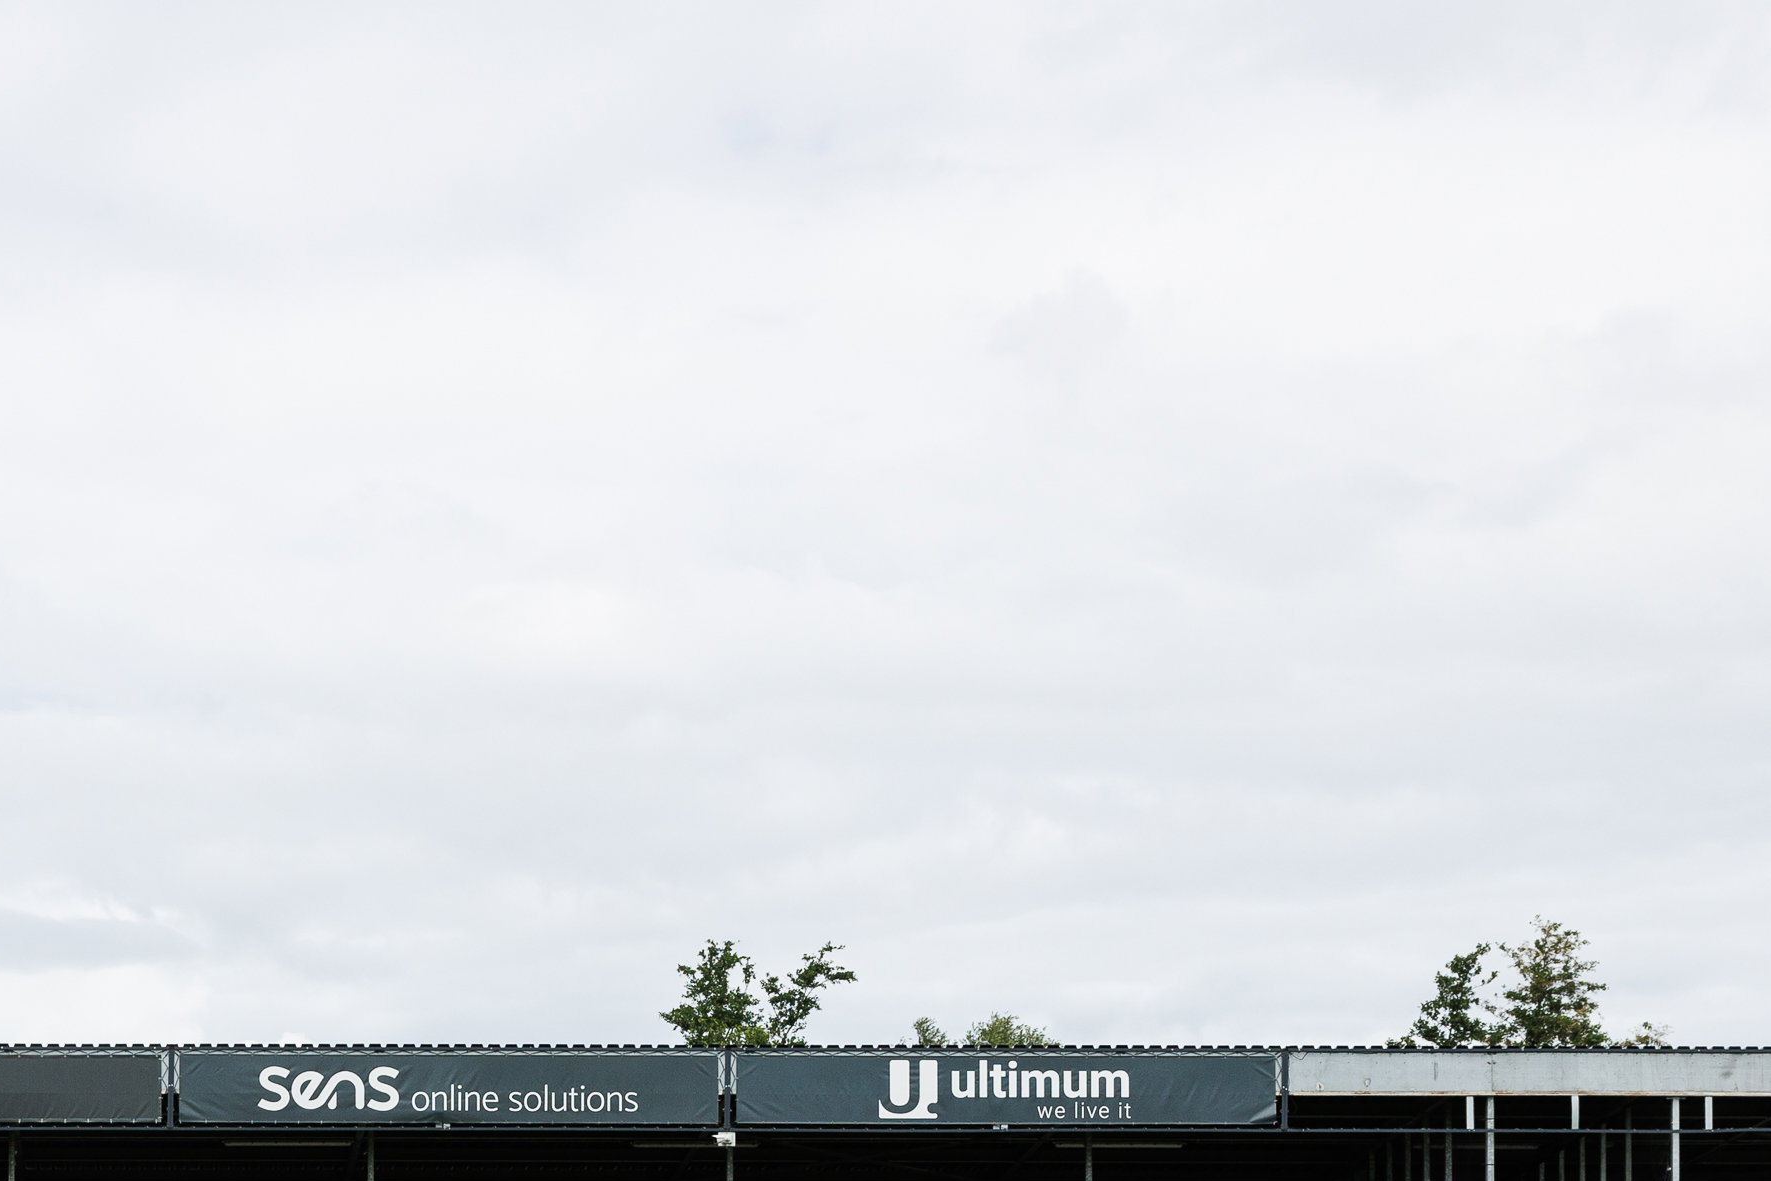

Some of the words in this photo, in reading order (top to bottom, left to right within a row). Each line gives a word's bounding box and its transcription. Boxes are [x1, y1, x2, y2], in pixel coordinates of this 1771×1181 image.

[951, 1059, 1130, 1099] ultimum
[411, 1083, 499, 1112] online
[508, 1083, 639, 1113] solutions
[1037, 1105, 1066, 1119] we
[1074, 1101, 1110, 1119] live
[1118, 1101, 1132, 1119] it
